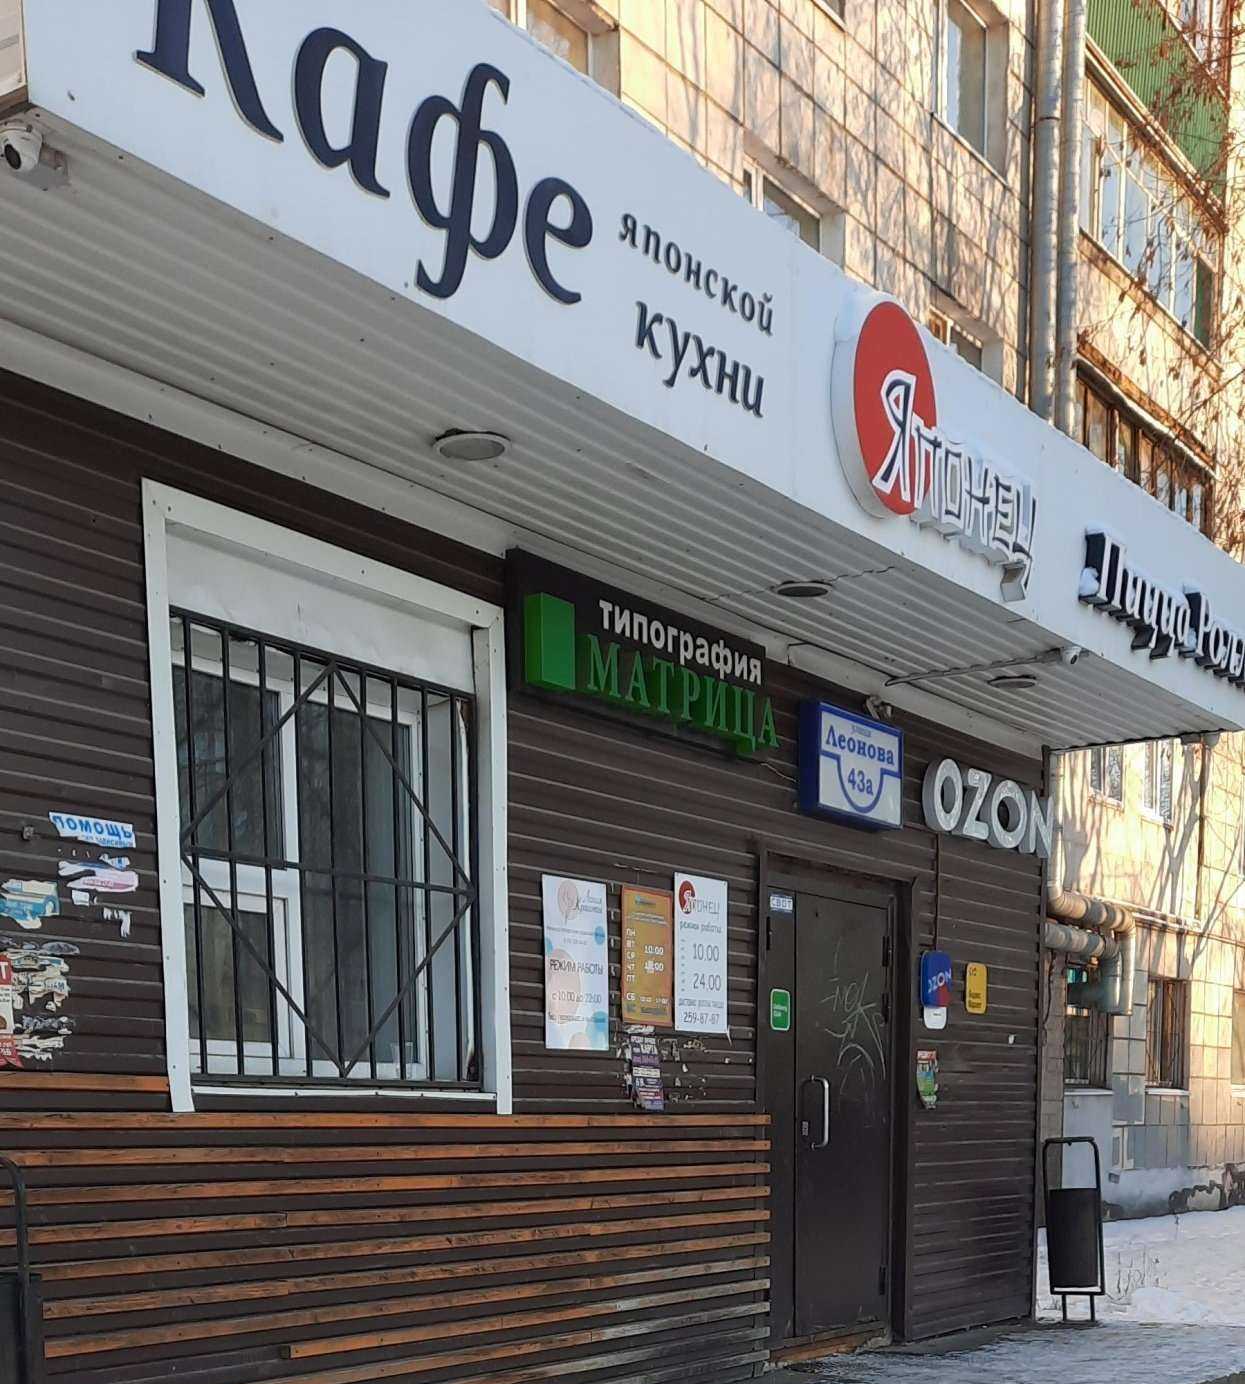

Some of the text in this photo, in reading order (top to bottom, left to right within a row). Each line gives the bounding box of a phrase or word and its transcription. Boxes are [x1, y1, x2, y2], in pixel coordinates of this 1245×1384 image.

[619, 213, 773, 336] японской
[635, 300, 764, 418] кухни
[599, 600, 762, 685] типография
[587, 634, 780, 752] МАТРИЦА
[826, 724, 895, 766] Леонова
[847, 767, 874, 796] 43а
[928, 758, 1054, 859] OZON
[549, 959, 576, 972] РЕЖИМ
